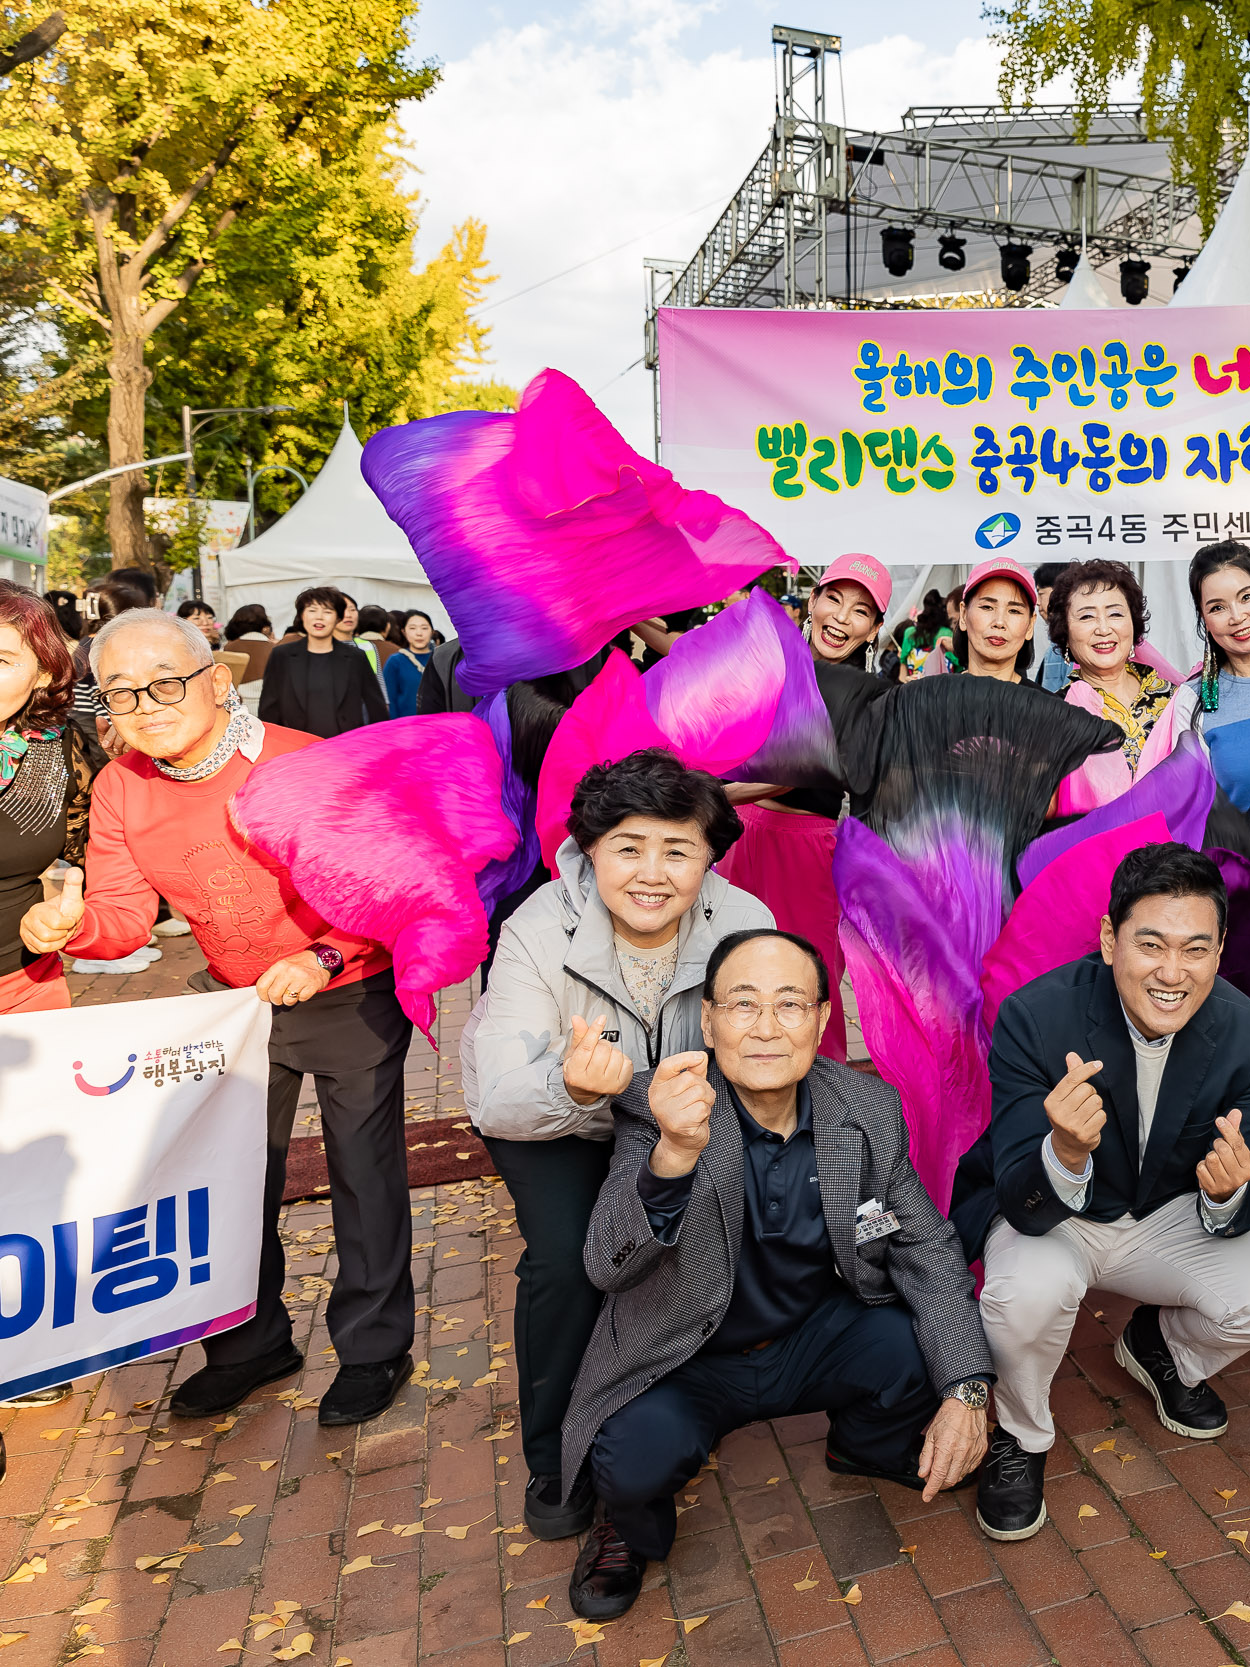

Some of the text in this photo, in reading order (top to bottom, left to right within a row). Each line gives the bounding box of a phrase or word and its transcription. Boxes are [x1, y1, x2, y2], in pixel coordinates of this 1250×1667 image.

[850, 340, 996, 415] 올해의
[1008, 339, 1181, 414] 주인공은
[755, 419, 957, 500] 밸리댄스
[968, 420, 1170, 498] 중곡4동의
[1035, 513, 1147, 546] 중곡4동
[143, 1040, 224, 1063] 소통하며 발전하는
[142, 1053, 225, 1087] 행복광진
